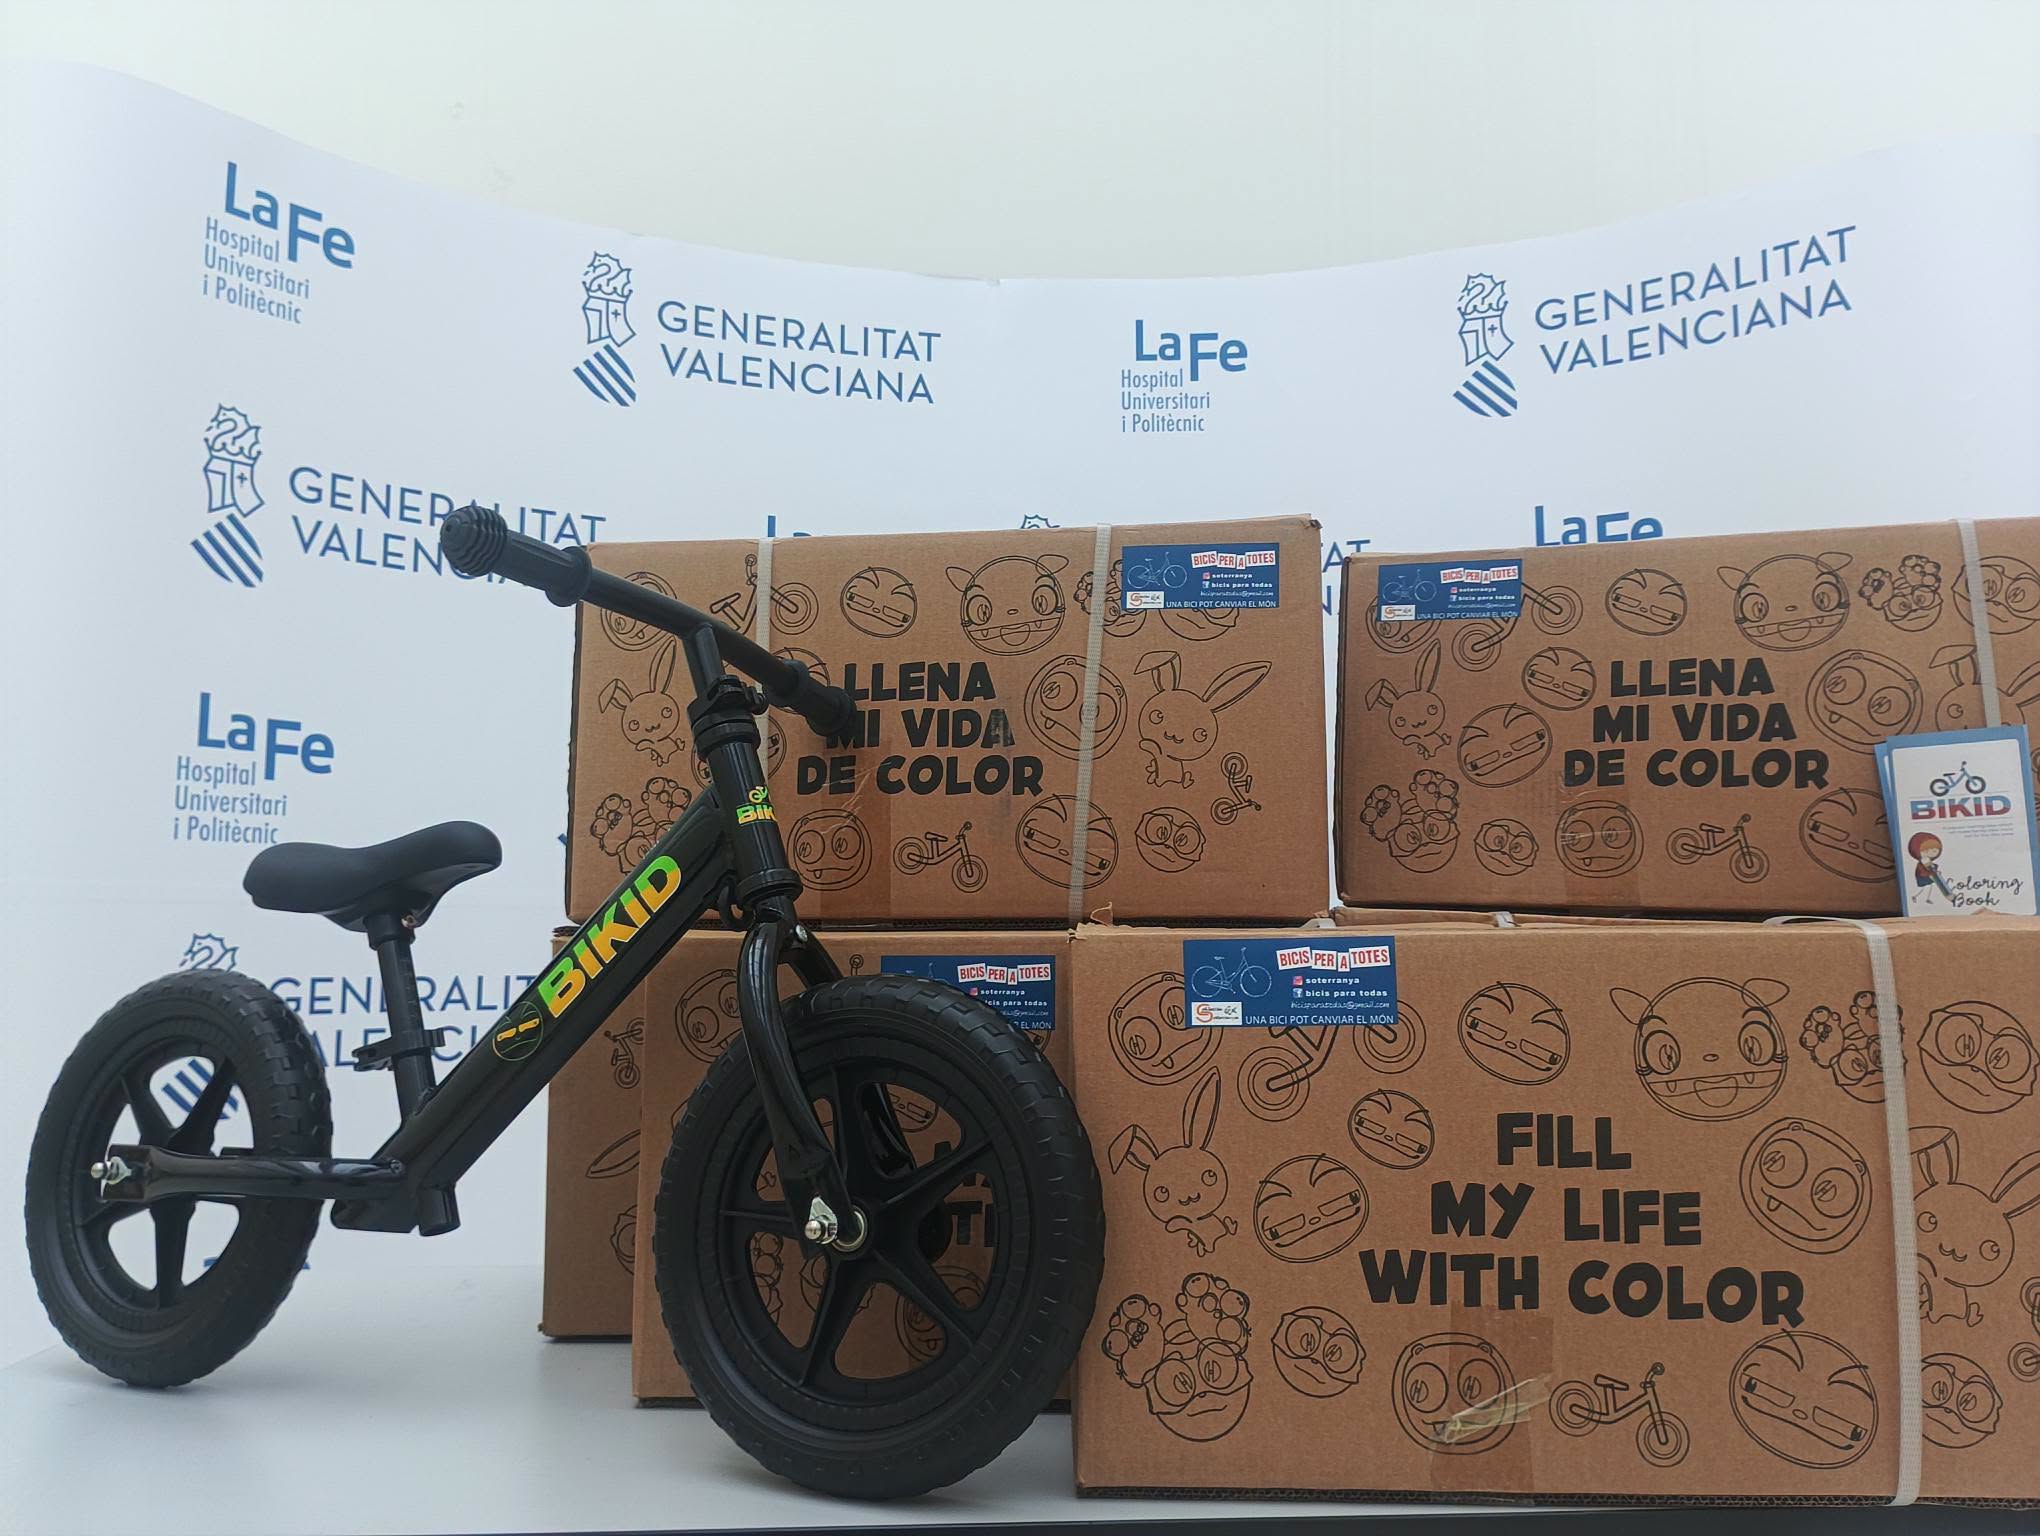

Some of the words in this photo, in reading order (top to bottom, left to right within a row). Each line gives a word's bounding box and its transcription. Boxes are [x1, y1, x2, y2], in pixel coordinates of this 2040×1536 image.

[223, 160, 279, 231] La
[287, 202, 355, 269] Fe
[205, 216, 280, 263] Hospital
[203, 244, 311, 299] Universitari
[1534, 225, 1857, 331] GENERALITAT
[202, 274, 210, 296] i
[215, 275, 302, 325] Politècnic
[657, 300, 941, 363] GENERALITAT
[1540, 277, 1853, 376] VALENCIANA
[1135, 318, 1181, 362] La
[1189, 331, 1248, 382] Fe
[660, 343, 934, 405] VALENCIANA
[1121, 368, 1184, 392] Hospital
[1121, 390, 1211, 412] Universitari
[1121, 413, 1126, 432] i
[1131, 411, 1204, 433] Politècnic
[289, 466, 606, 545] GENERITAT
[1193, 553, 1216, 565] BICIS
[1219, 556, 1235, 566] PER
[1238, 557, 1244, 568] A
[1247, 552, 1275, 564] TOTES
[1441, 569, 1464, 582] BICIS
[1466, 571, 1480, 581] PER
[1491, 567, 1517, 579] TOTES
[844, 661, 996, 701] LLENA
[1610, 657, 1775, 697] LLENA
[197, 691, 256, 752] La
[264, 718, 335, 780] Fe
[901, 708, 1015, 748] VIDA
[1593, 703, 1650, 743] MI
[1672, 702, 1797, 742] VIDA
[176, 756, 256, 787] Hospital
[797, 755, 856, 795] DE
[876, 754, 1043, 796] COLOR
[1564, 749, 1626, 787] DE
[1646, 748, 1830, 790] COLOR
[174, 786, 288, 817] Universitari
[1910, 795, 2012, 820] BIKID
[173, 818, 180, 840] i
[186, 816, 279, 844] Politècnic
[1946, 876, 2023, 895] Coloring
[1952, 892, 2000, 908] Book
[538, 855, 682, 1018] BIKID
[960, 966, 985, 980] BICIS
[988, 969, 1005, 980] PER
[1009, 971, 1016, 983] A
[1019, 966, 1050, 979] TOTES
[1279, 951, 1310, 967] BICIS
[1314, 953, 1334, 967] PER
[1340, 955, 1347, 969] A
[1351, 949, 1388, 964] TOTES
[268, 975, 541, 1014] GENRALI
[1305, 977, 1360, 985] soterranya
[1305, 989, 1330, 997] bicis
[1333, 990, 1356, 998] para
[1360, 989, 1387, 997] todas
[1245, 1016, 1266, 1024] UNA
[1269, 1016, 1287, 1024] BICI
[1290, 1015, 1309, 1024] POT
[1311, 1015, 1354, 1024] CANVIAR
[1356, 1015, 1367, 1024] EL
[1370, 1014, 1394, 1024] MÓN
[1497, 1112, 1632, 1170] FILL
[1430, 1180, 1535, 1239] MY
[1564, 1187, 1701, 1246] LIFE
[1359, 1249, 1539, 1310] WITH
[1568, 1259, 1804, 1328] COLOR
